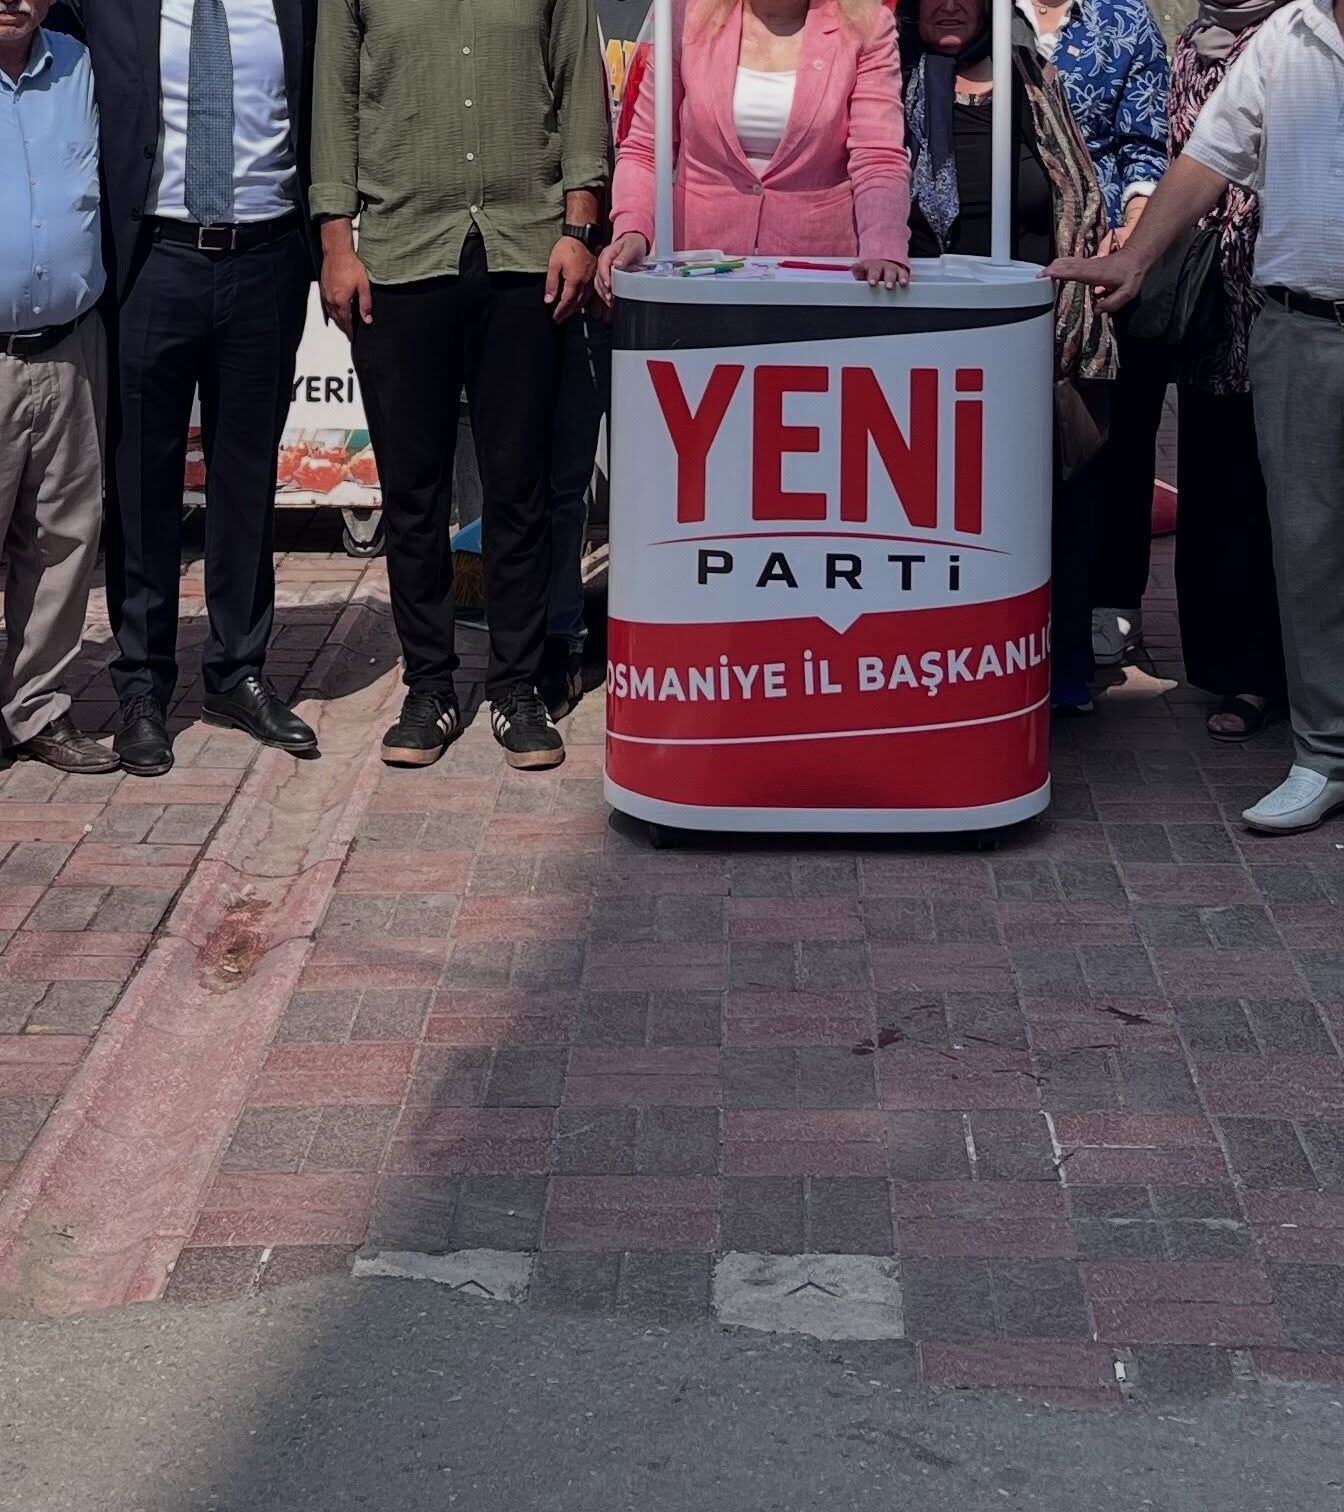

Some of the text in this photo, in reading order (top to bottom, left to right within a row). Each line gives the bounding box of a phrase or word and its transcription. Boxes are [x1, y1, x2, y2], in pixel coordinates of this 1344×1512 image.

[645, 358, 984, 535] YENİ
[698, 549, 961, 591] PARTİ
[803, 648, 842, 696] İL
